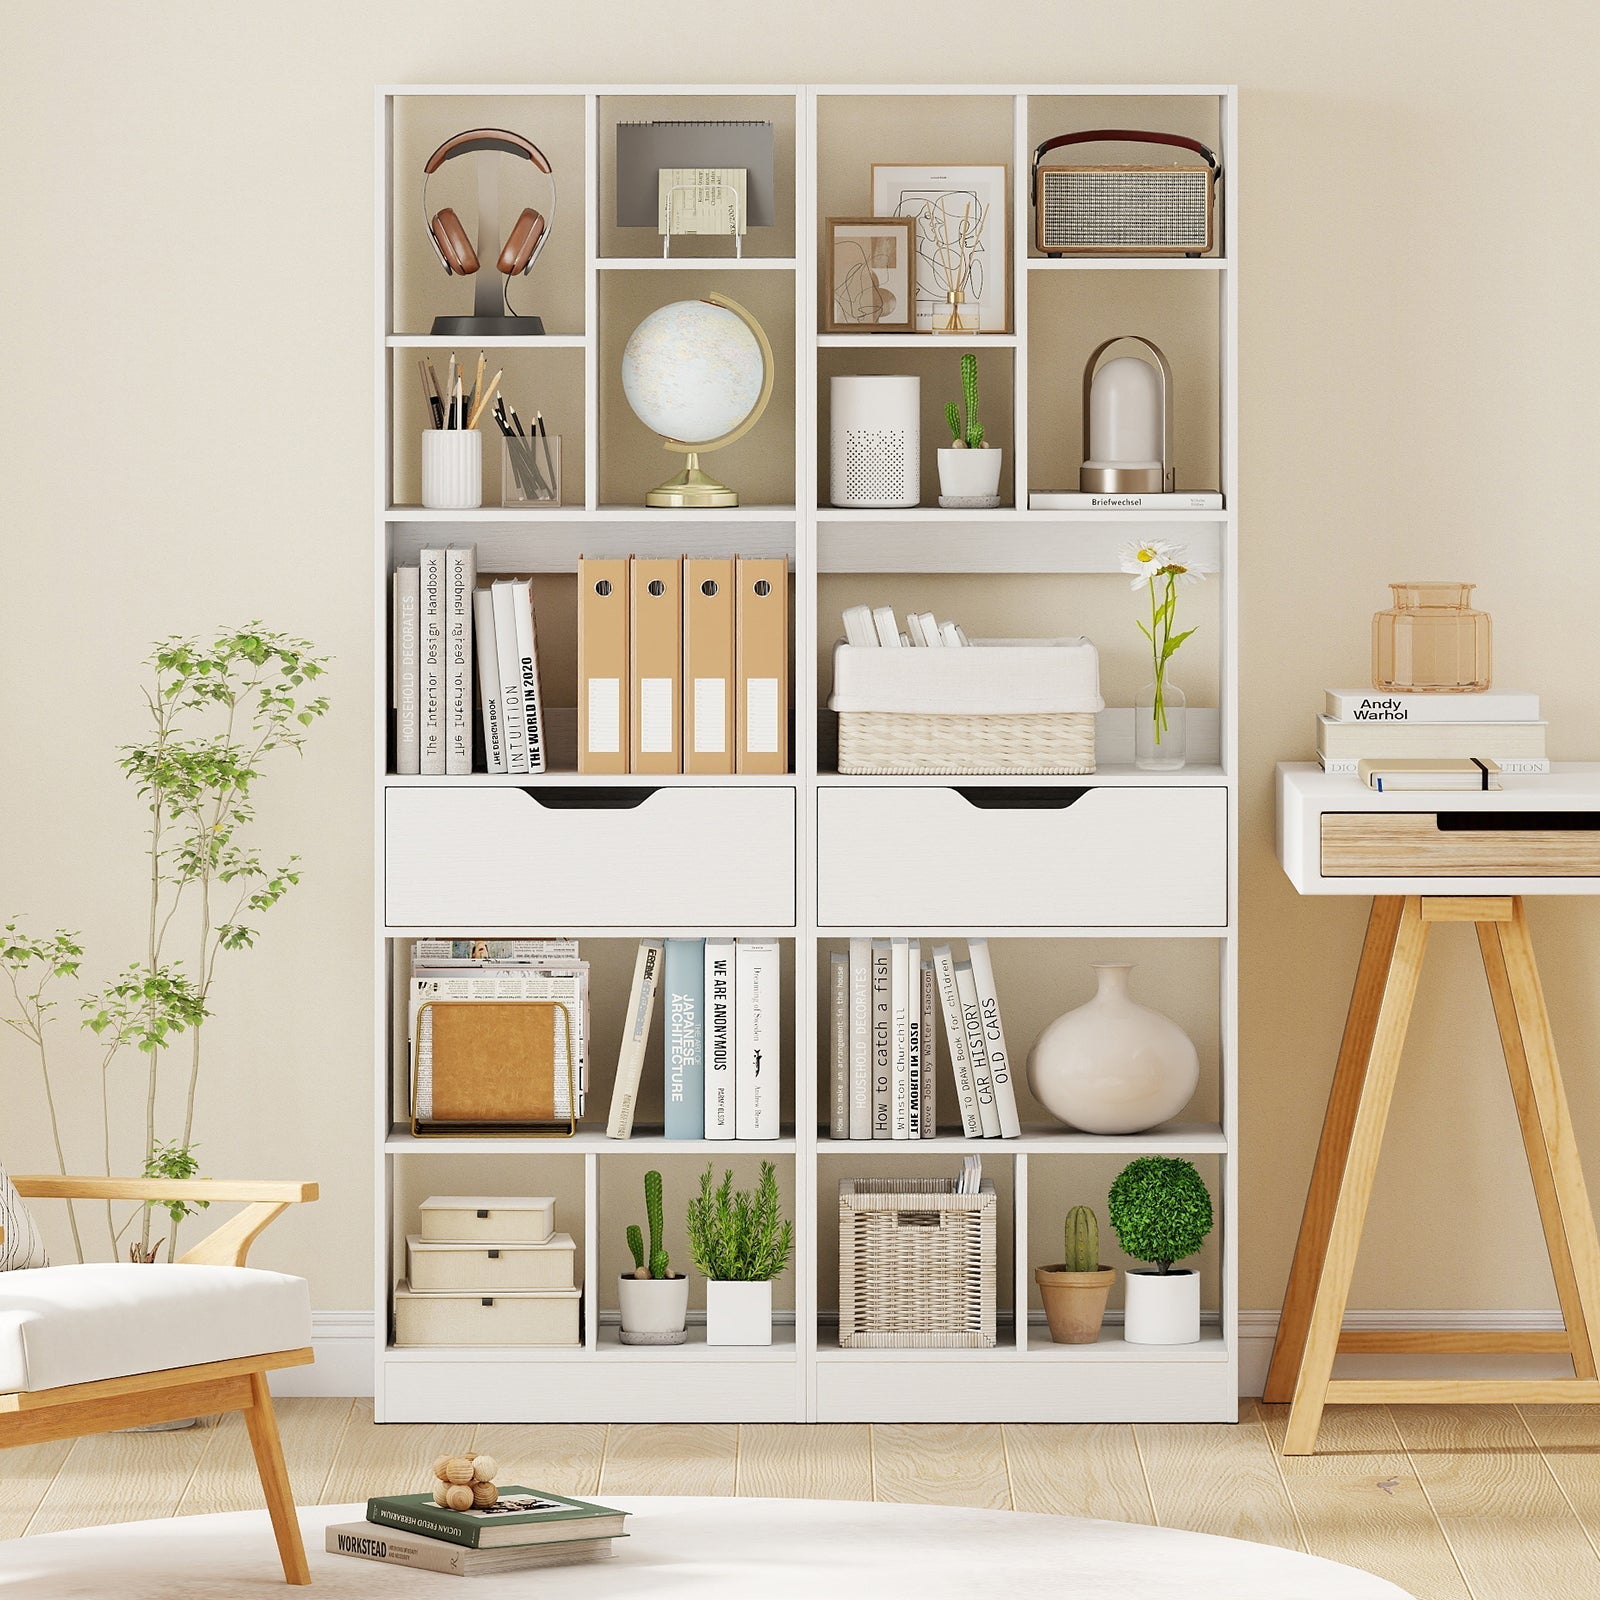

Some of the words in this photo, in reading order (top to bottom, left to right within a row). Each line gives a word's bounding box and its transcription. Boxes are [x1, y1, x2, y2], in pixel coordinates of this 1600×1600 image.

[427, 560, 437, 615] Handbook
[402, 595, 414, 664] DECORATES
[427, 623, 439, 664] Design
[522, 657, 534, 687] 2020
[403, 673, 414, 742] HOUSEHOLD
[427, 672, 437, 727] Interior
[525, 689, 535, 701] IN
[1360, 699, 1401, 711] Andy
[505, 685, 524, 768] INTUITION
[525, 704, 538, 744] WORLD
[1353, 710, 1407, 720] Warhol
[427, 735, 437, 756] The
[530, 747, 541, 768] THE
[1332, 763, 1356, 772] DIO
[1501, 763, 1543, 772] UTION
[714, 960, 726, 976] WE
[875, 958, 887, 992] fish
[714, 980, 726, 999] ARE
[752, 967, 761, 1003] Dreaming
[941, 959, 955, 1007] children
[837, 1009, 843, 1017] in
[856, 968, 866, 1033] DECORATES
[683, 994, 694, 1066] JAPANESE
[950, 1014, 959, 1030] for
[982, 998, 1000, 1040] CARS
[672, 994, 682, 1102] ARCHITECTURE
[714, 1004, 726, 1071] ANONYMOUS
[837, 1022, 845, 1068] arrangement
[875, 1022, 887, 1066] catch
[897, 1008, 905, 1072] Churchill
[964, 1002, 986, 1067] HISTORY
[954, 1037, 965, 1061] Book
[838, 1072, 843, 1081] an
[856, 1042, 866, 1108] HOUSEHOLD
[924, 1061, 932, 1072] by
[960, 1066, 971, 1091] DRAW
[992, 1052, 1008, 1084] OLD
[877, 1077, 887, 1093] to
[979, 1076, 992, 1104] CAR
[837, 1106, 843, 1114] to
[897, 1080, 905, 1130] Winston
[965, 1096, 973, 1108] TO
[875, 1104, 887, 1131] How
[967, 1114, 977, 1132] HOW
[381, 1510, 417, 1525] HERBARIUM
[418, 1519, 437, 1530] FREUD
[438, 1525, 461, 1536] LUCIAN
[338, 1534, 386, 1557] WORKSTEAD
